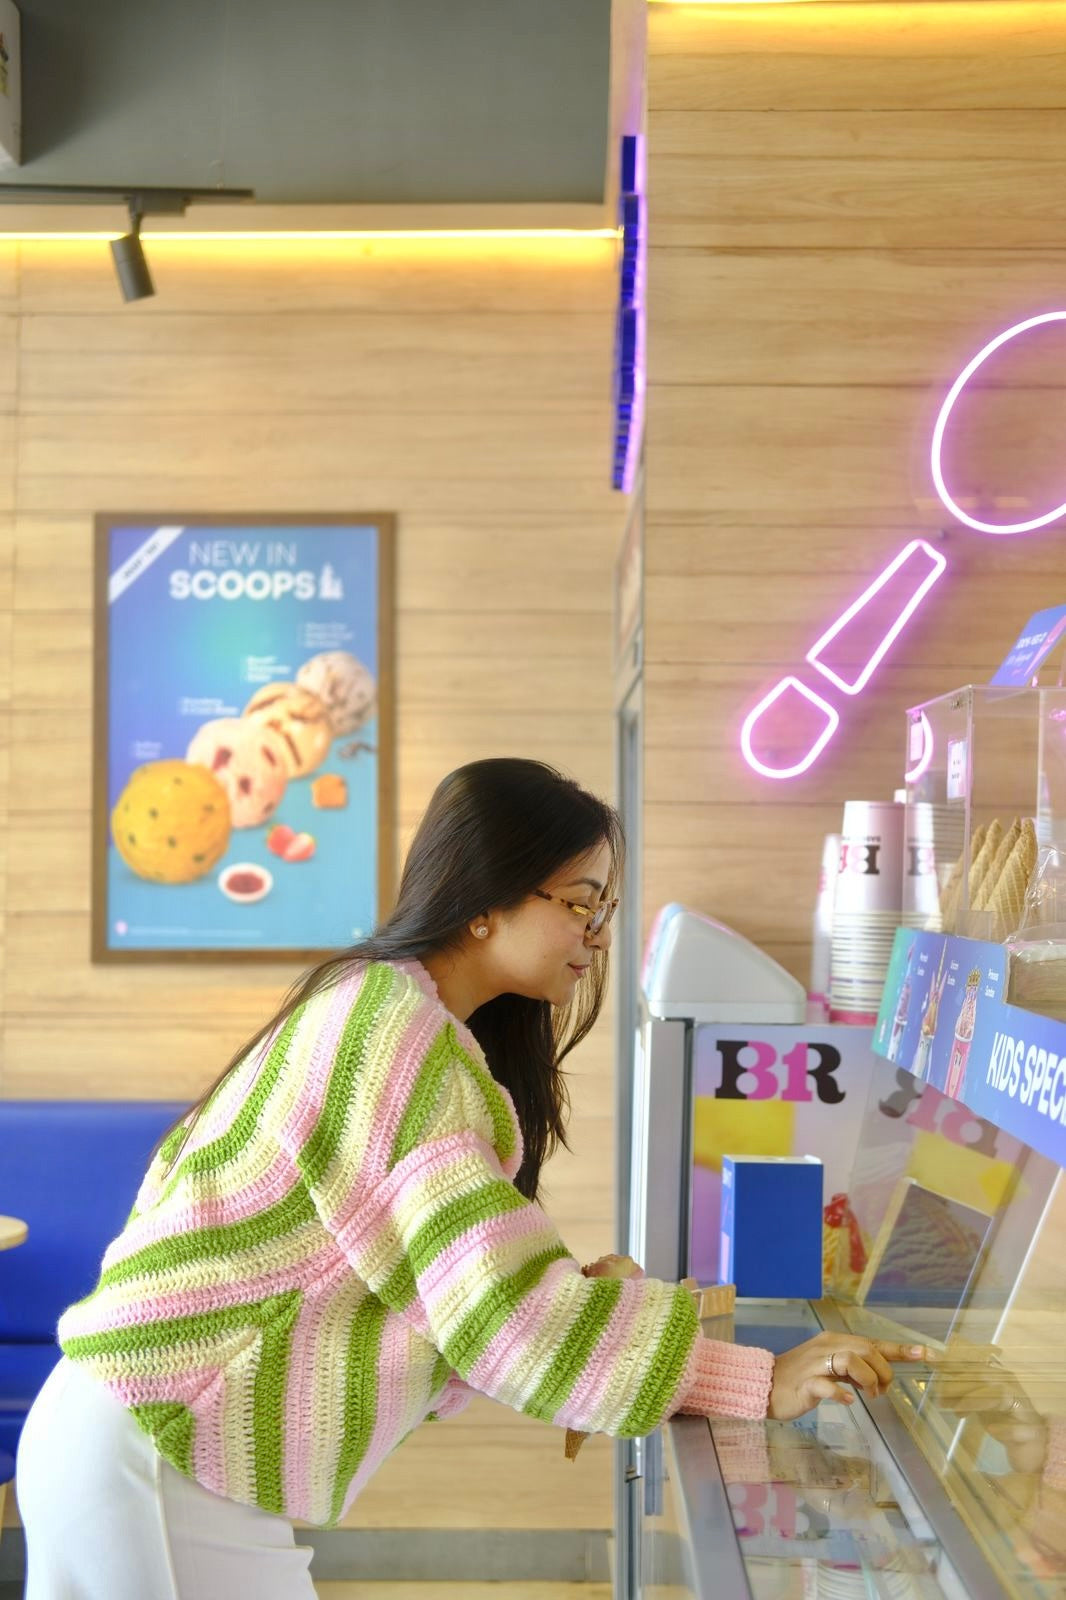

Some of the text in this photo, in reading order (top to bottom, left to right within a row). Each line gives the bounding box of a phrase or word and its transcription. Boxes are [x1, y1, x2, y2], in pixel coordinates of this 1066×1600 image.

[189, 541, 297, 566] NEW IN
[169, 570, 316, 600] SCOOPS
[986, 1031, 1066, 1127] KIDS SPEC
